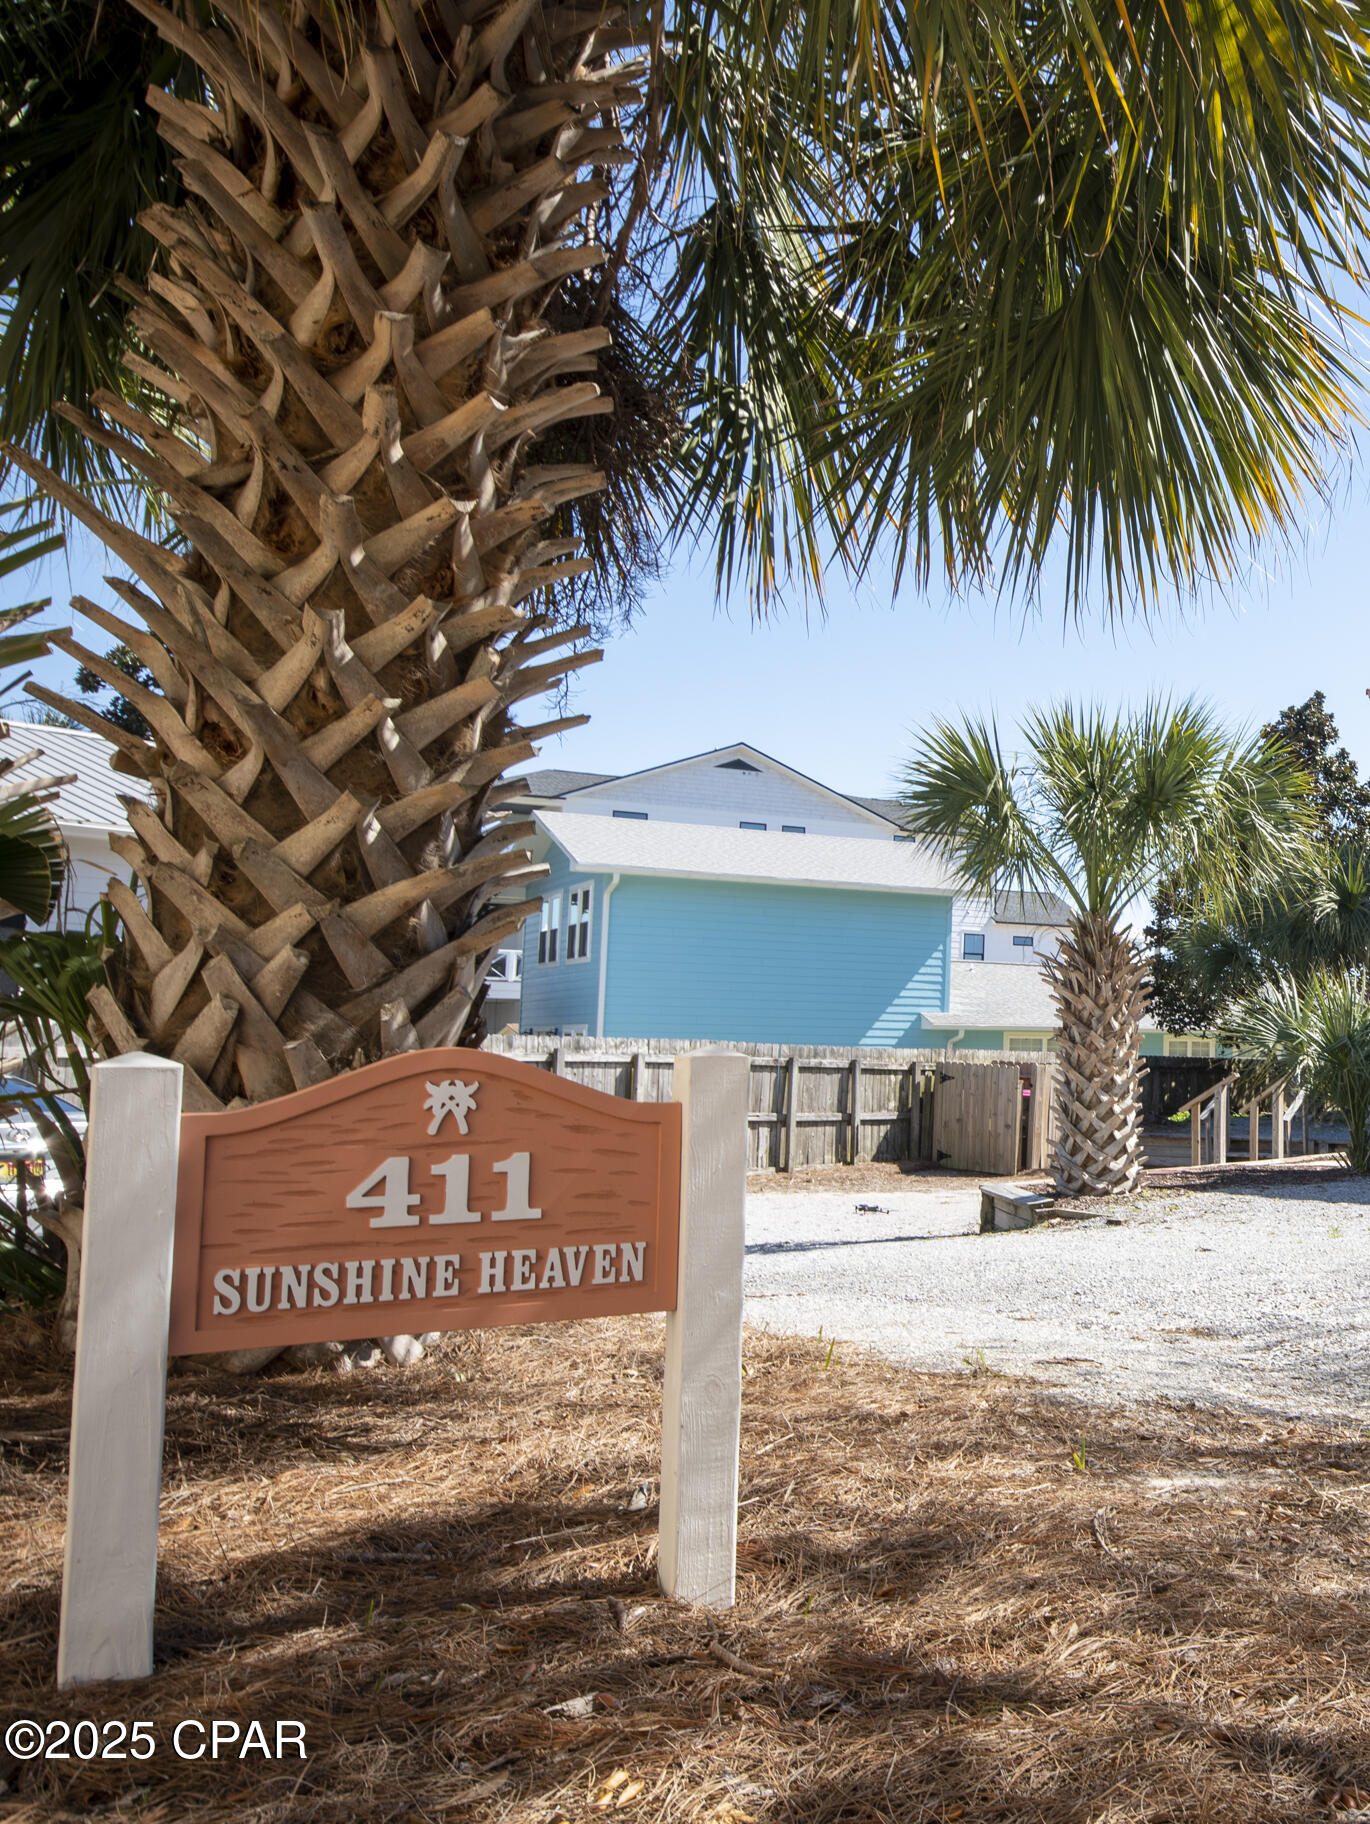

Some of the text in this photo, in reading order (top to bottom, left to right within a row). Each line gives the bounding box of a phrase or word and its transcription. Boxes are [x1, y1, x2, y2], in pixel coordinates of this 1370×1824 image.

[346, 1151, 542, 1229] 411
[212, 1241, 648, 1315] SUNSHINE HEAVEN
